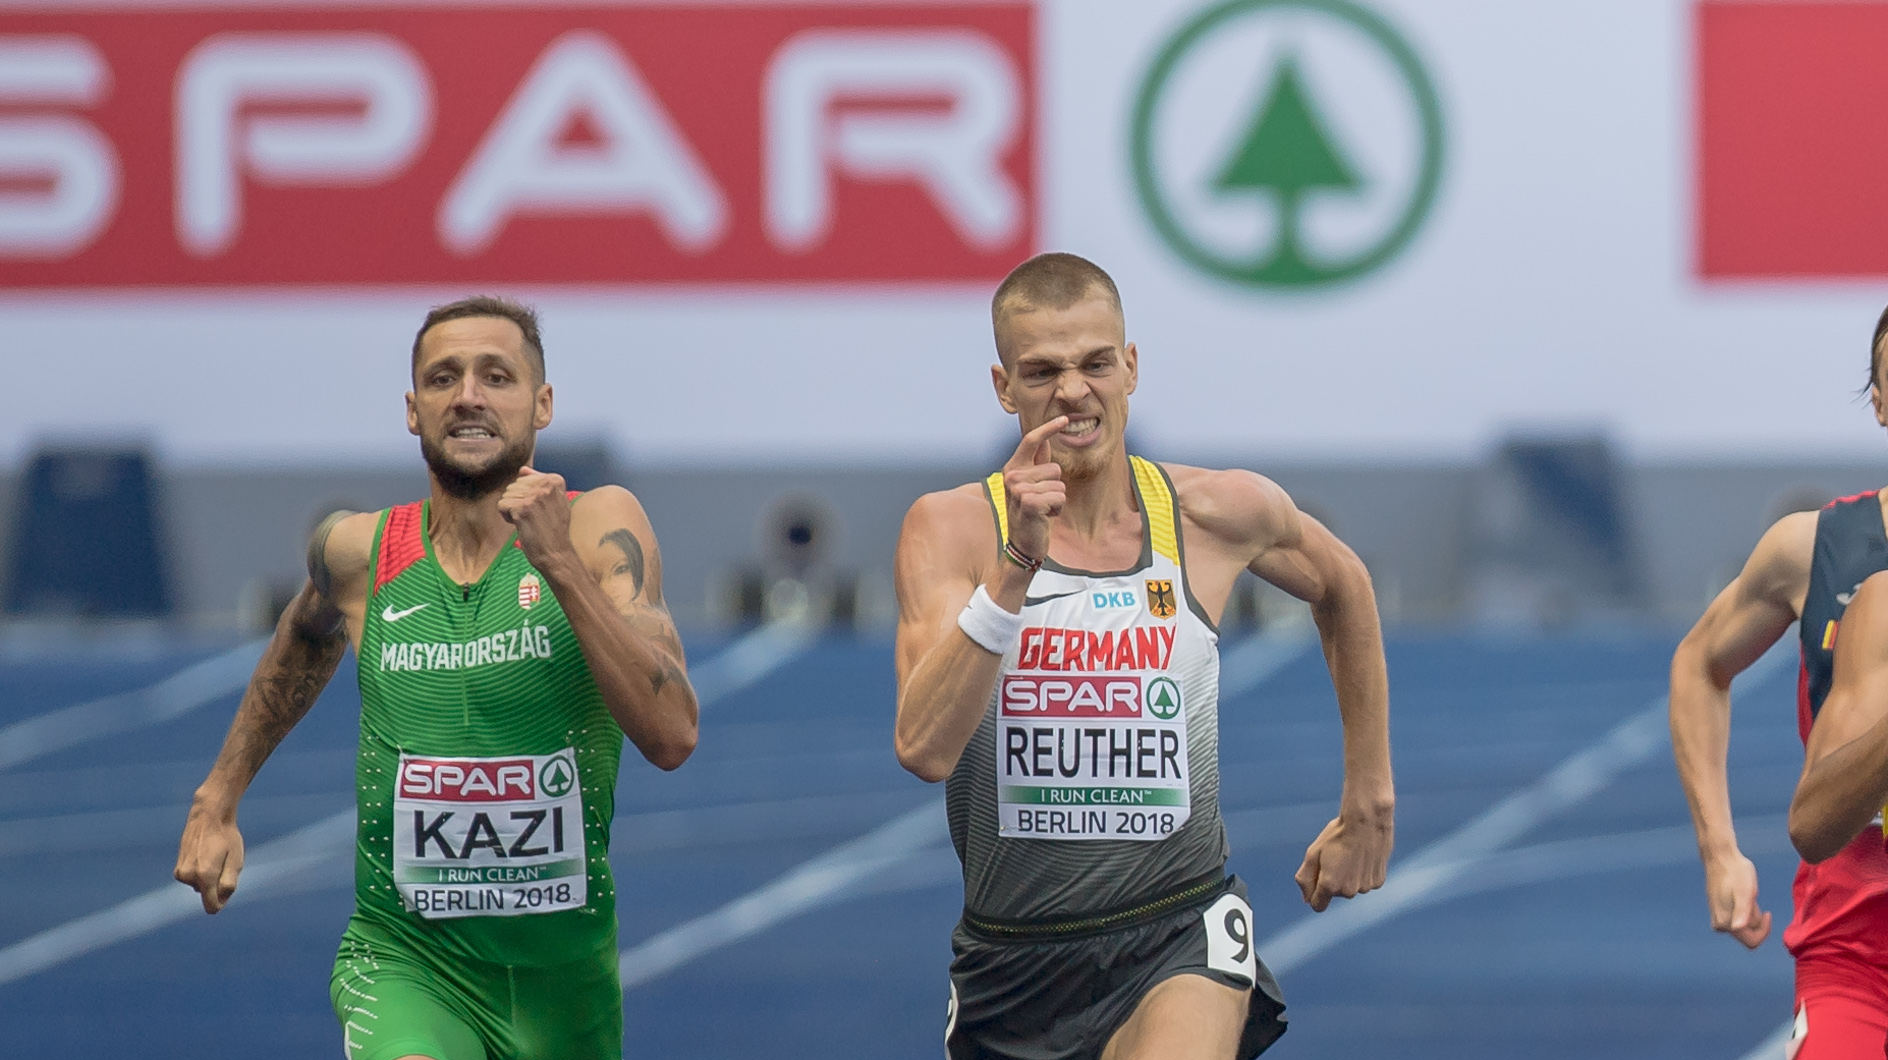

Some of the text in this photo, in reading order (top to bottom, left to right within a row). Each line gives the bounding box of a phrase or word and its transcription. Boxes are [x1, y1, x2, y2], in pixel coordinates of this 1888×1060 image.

[1093, 591, 1136, 608] DKB
[380, 619, 551, 671] MAGYARORSZÁG
[1017, 624, 1176, 671] GERMANY
[1005, 681, 1139, 712] SPAR
[1006, 726, 1182, 779] REUTHER
[403, 764, 531, 795] SPAR
[1041, 789, 1045, 801] I
[1050, 789, 1083, 802] RUN
[414, 806, 564, 859] KAZI
[1018, 810, 1175, 835] BERLIN 2018
[438, 868, 443, 882] I
[449, 869, 482, 882] RUN
[414, 883, 571, 912] BERLIN 2018
[1224, 908, 1249, 962] 9
